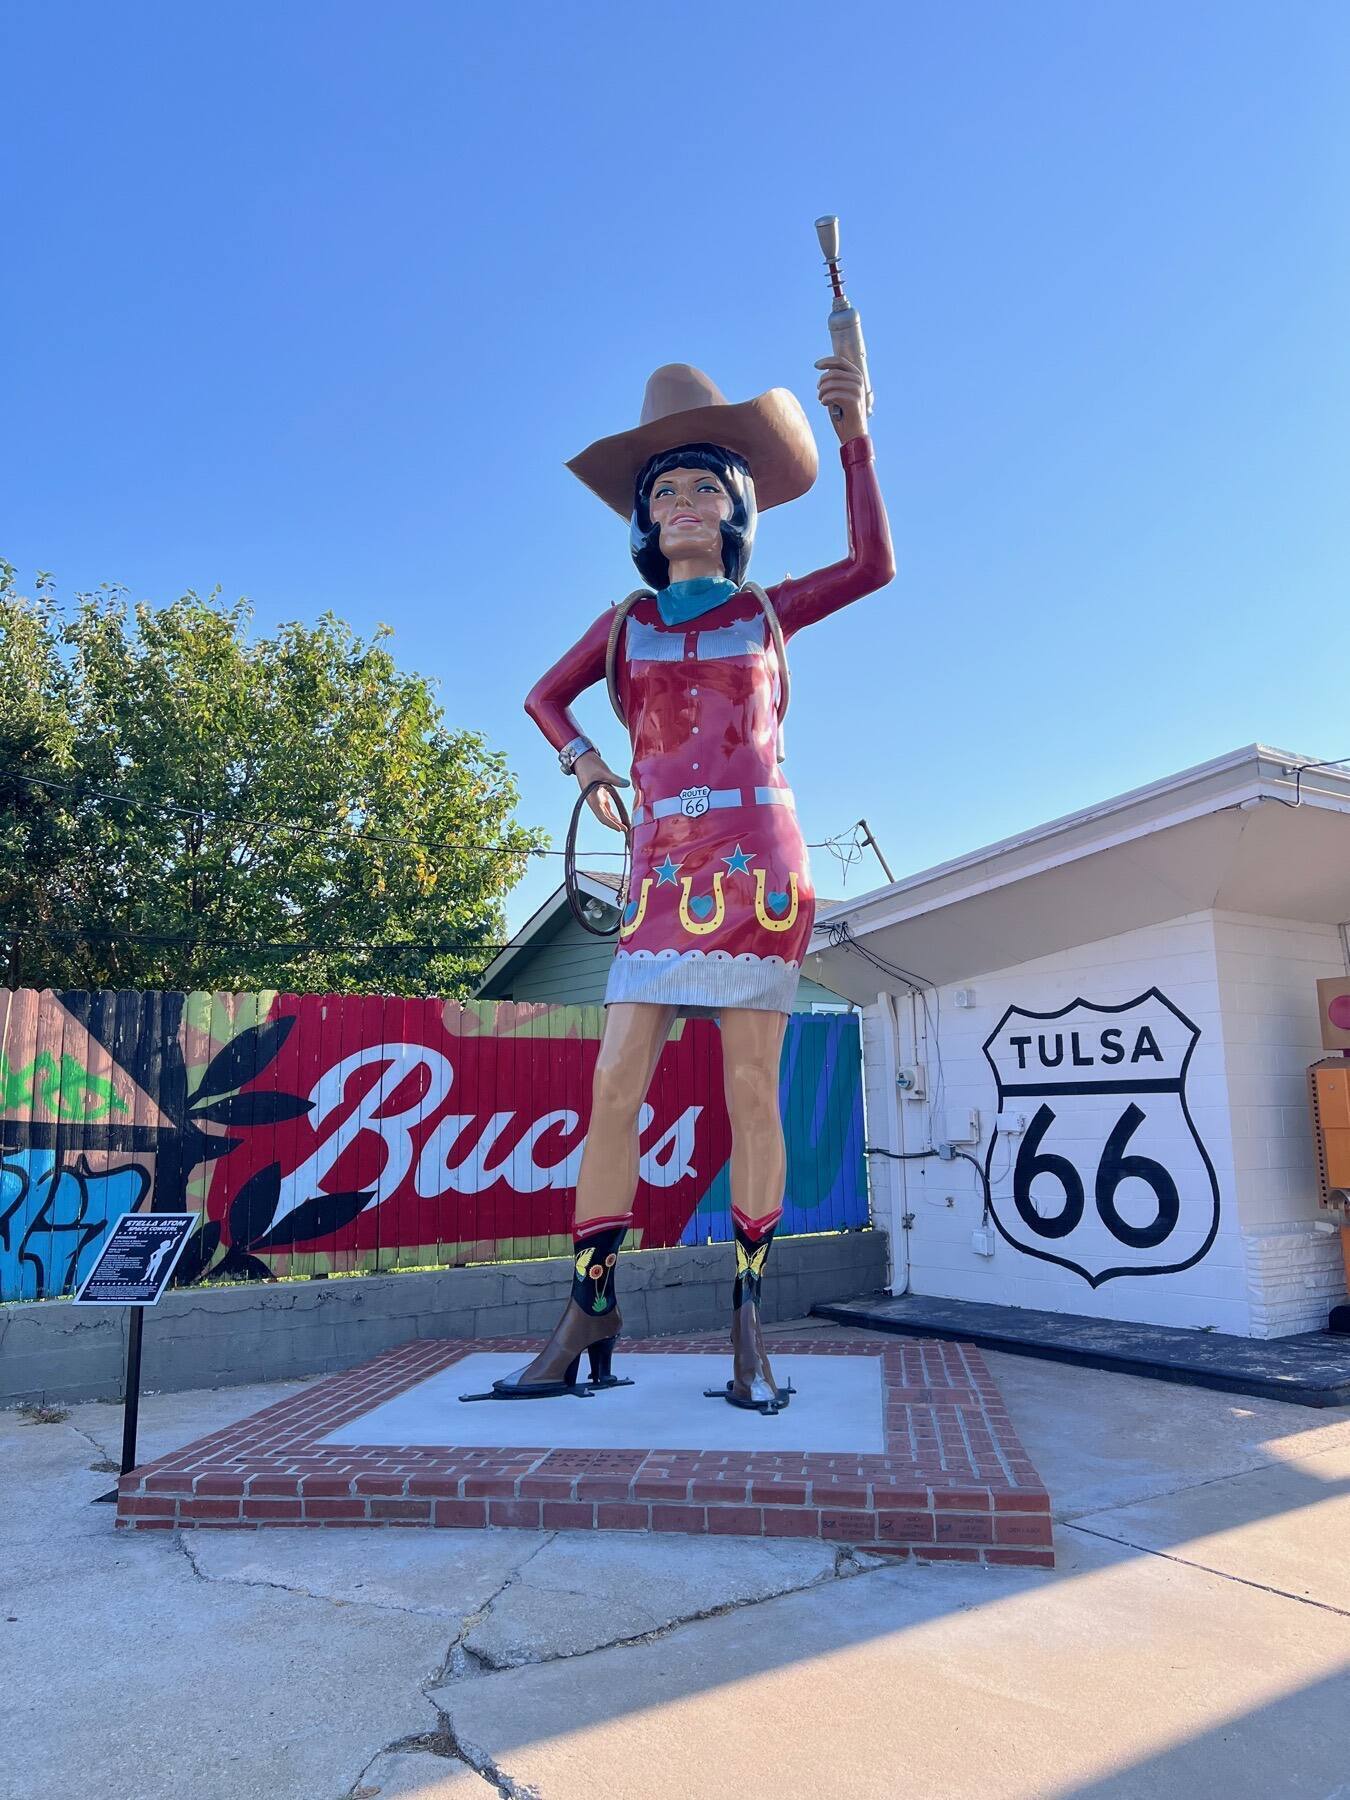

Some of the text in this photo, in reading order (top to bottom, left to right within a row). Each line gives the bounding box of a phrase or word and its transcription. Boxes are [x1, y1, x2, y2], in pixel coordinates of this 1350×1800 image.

[682, 789, 707, 798] ROUTE
[686, 799, 704, 814] 66
[1009, 1025, 1164, 1069] TULSA
[1013, 1101, 1180, 1249] 66
